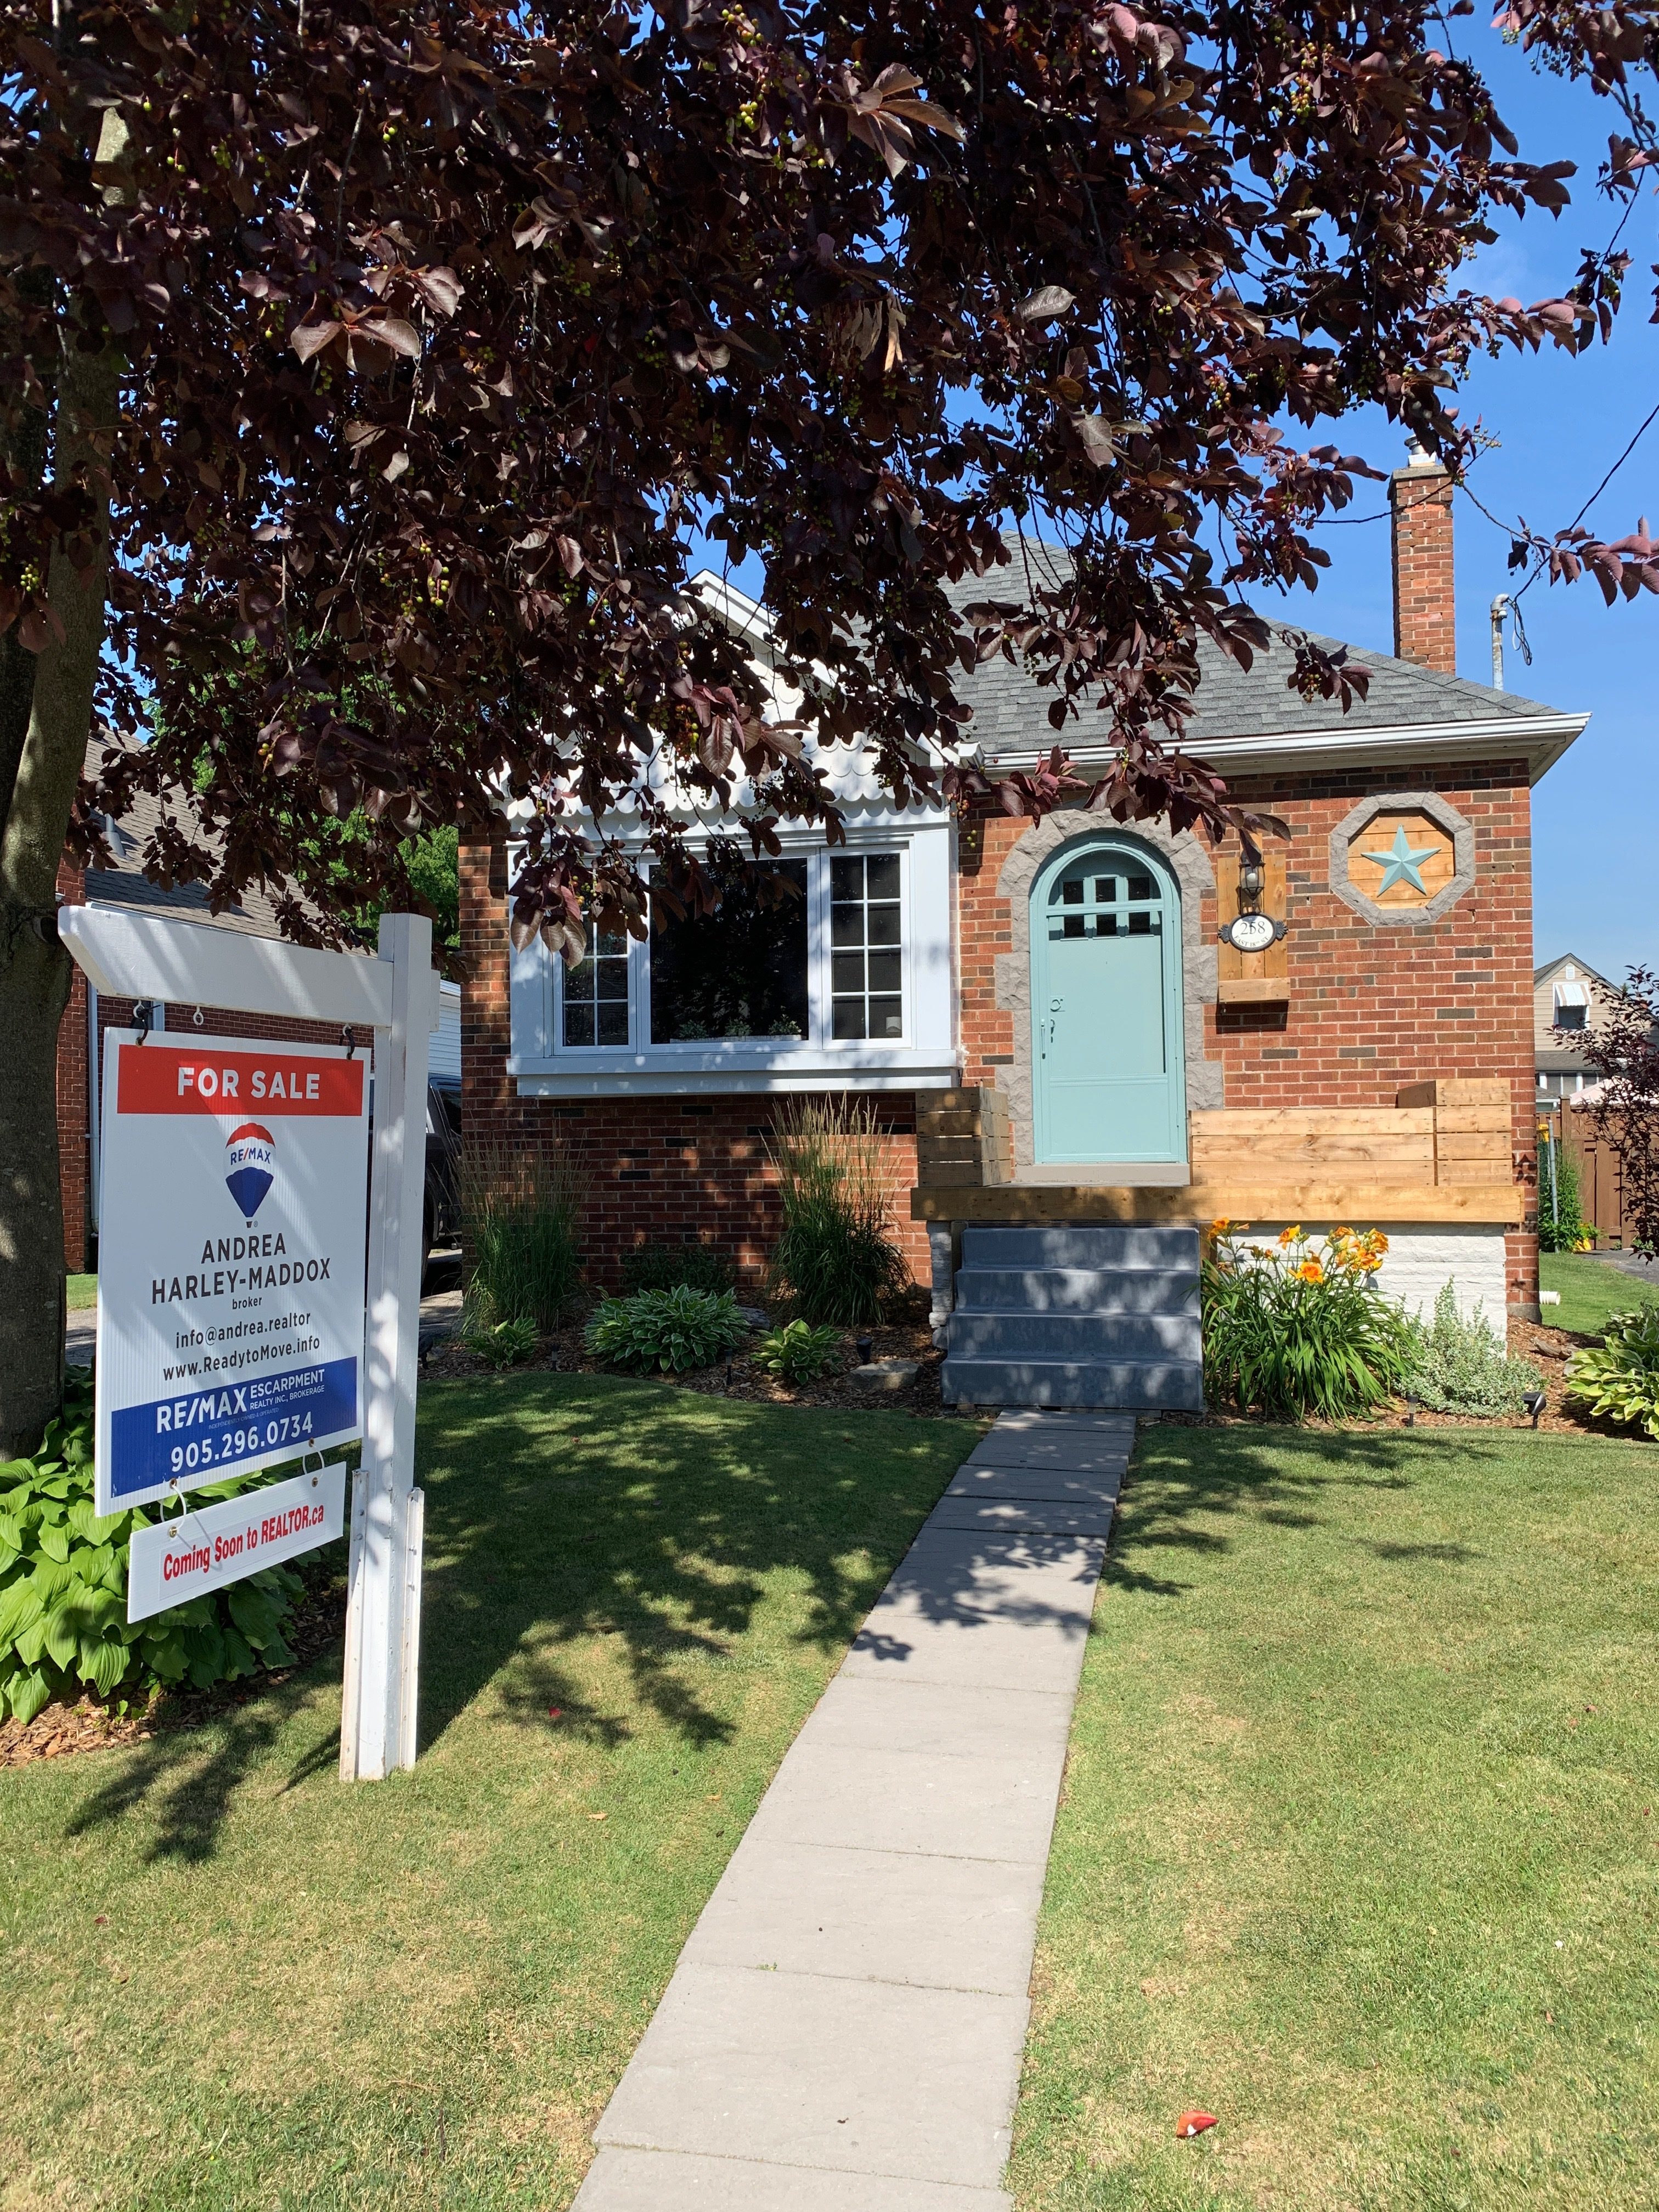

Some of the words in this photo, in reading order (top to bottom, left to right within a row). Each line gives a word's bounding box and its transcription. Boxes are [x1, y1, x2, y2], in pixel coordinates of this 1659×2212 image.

[1234, 935, 1249, 946] EAST
[1261, 936, 1270, 944] ST.
[1240, 921, 1265, 935] 258
[177, 1066, 239, 1097] FOR
[250, 1070, 320, 1099] SALE
[230, 1147, 271, 1166] RE/MAX
[201, 1233, 286, 1264] ANDREA
[151, 1257, 331, 1305] HARLEY-MADDOX
[232, 1296, 262, 1310] broker
[176, 1312, 311, 1348] info@andrea.realtor
[163, 1335, 320, 1381] www.ReadytoMove.info
[156, 1387, 247, 1434] RE/MAX
[250, 1368, 325, 1398] ESCARPMENT
[250, 1397, 274, 1410] REALTY
[290, 1385, 325, 1401] BROKERAGE
[208, 1417, 240, 1430] INDEPENDENTLY
[240, 1413, 256, 1422] OWNED
[259, 1407, 279, 1417] OPERATED
[171, 1411, 313, 1472] 905.296.0734
[163, 1544, 211, 1581] Coming
[215, 1534, 243, 1562] Soon
[246, 1526, 258, 1550] to
[261, 1505, 324, 1545] REALTOR.ca
